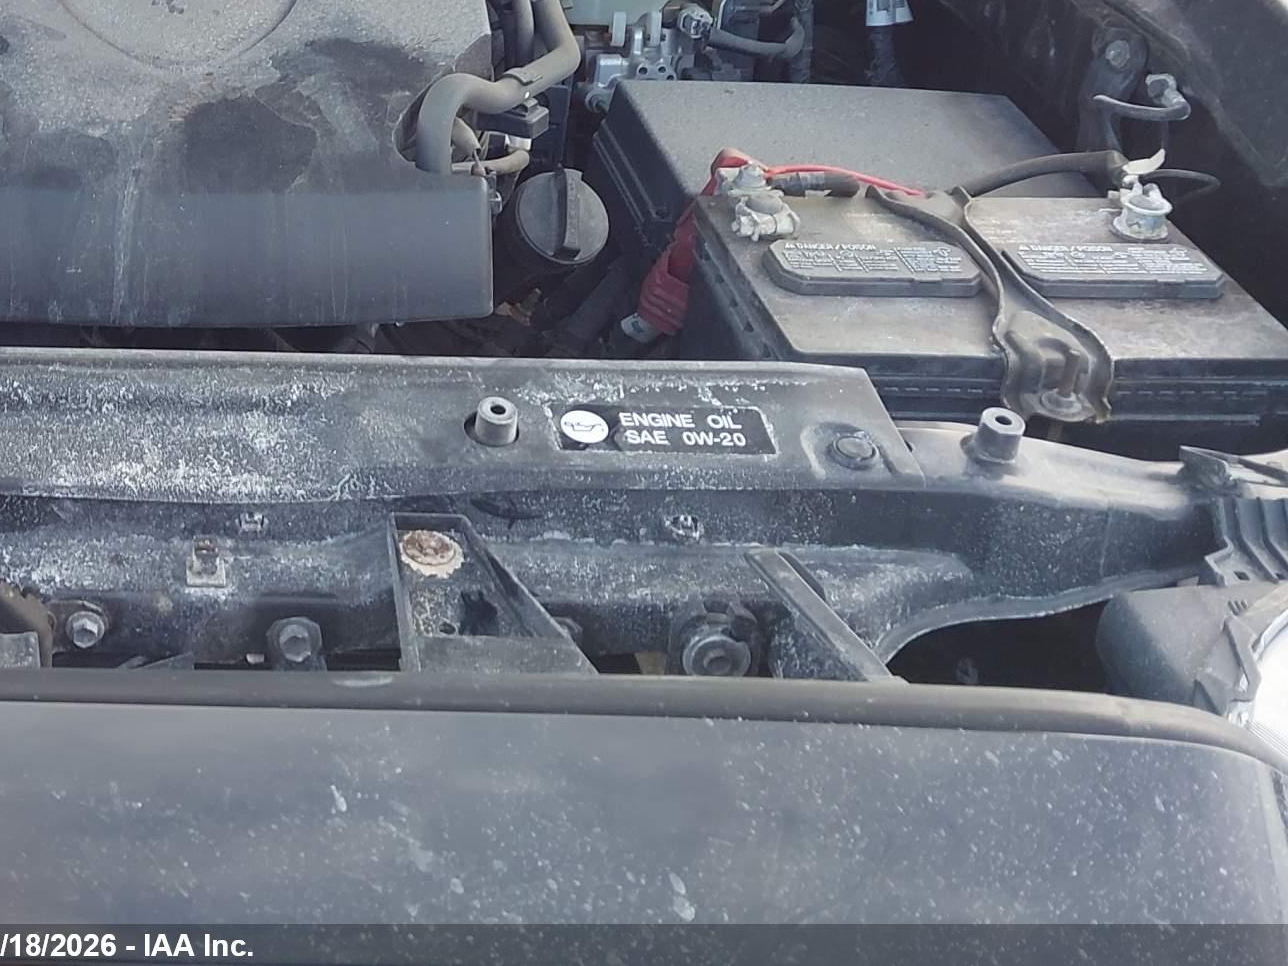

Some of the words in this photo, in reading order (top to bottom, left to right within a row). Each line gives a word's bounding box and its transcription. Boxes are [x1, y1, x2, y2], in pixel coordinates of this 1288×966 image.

[618, 412, 695, 428] ENGINE
[706, 414, 743, 430] OIL
[624, 429, 671, 446] SAE
[682, 431, 747, 447] 0W-20
